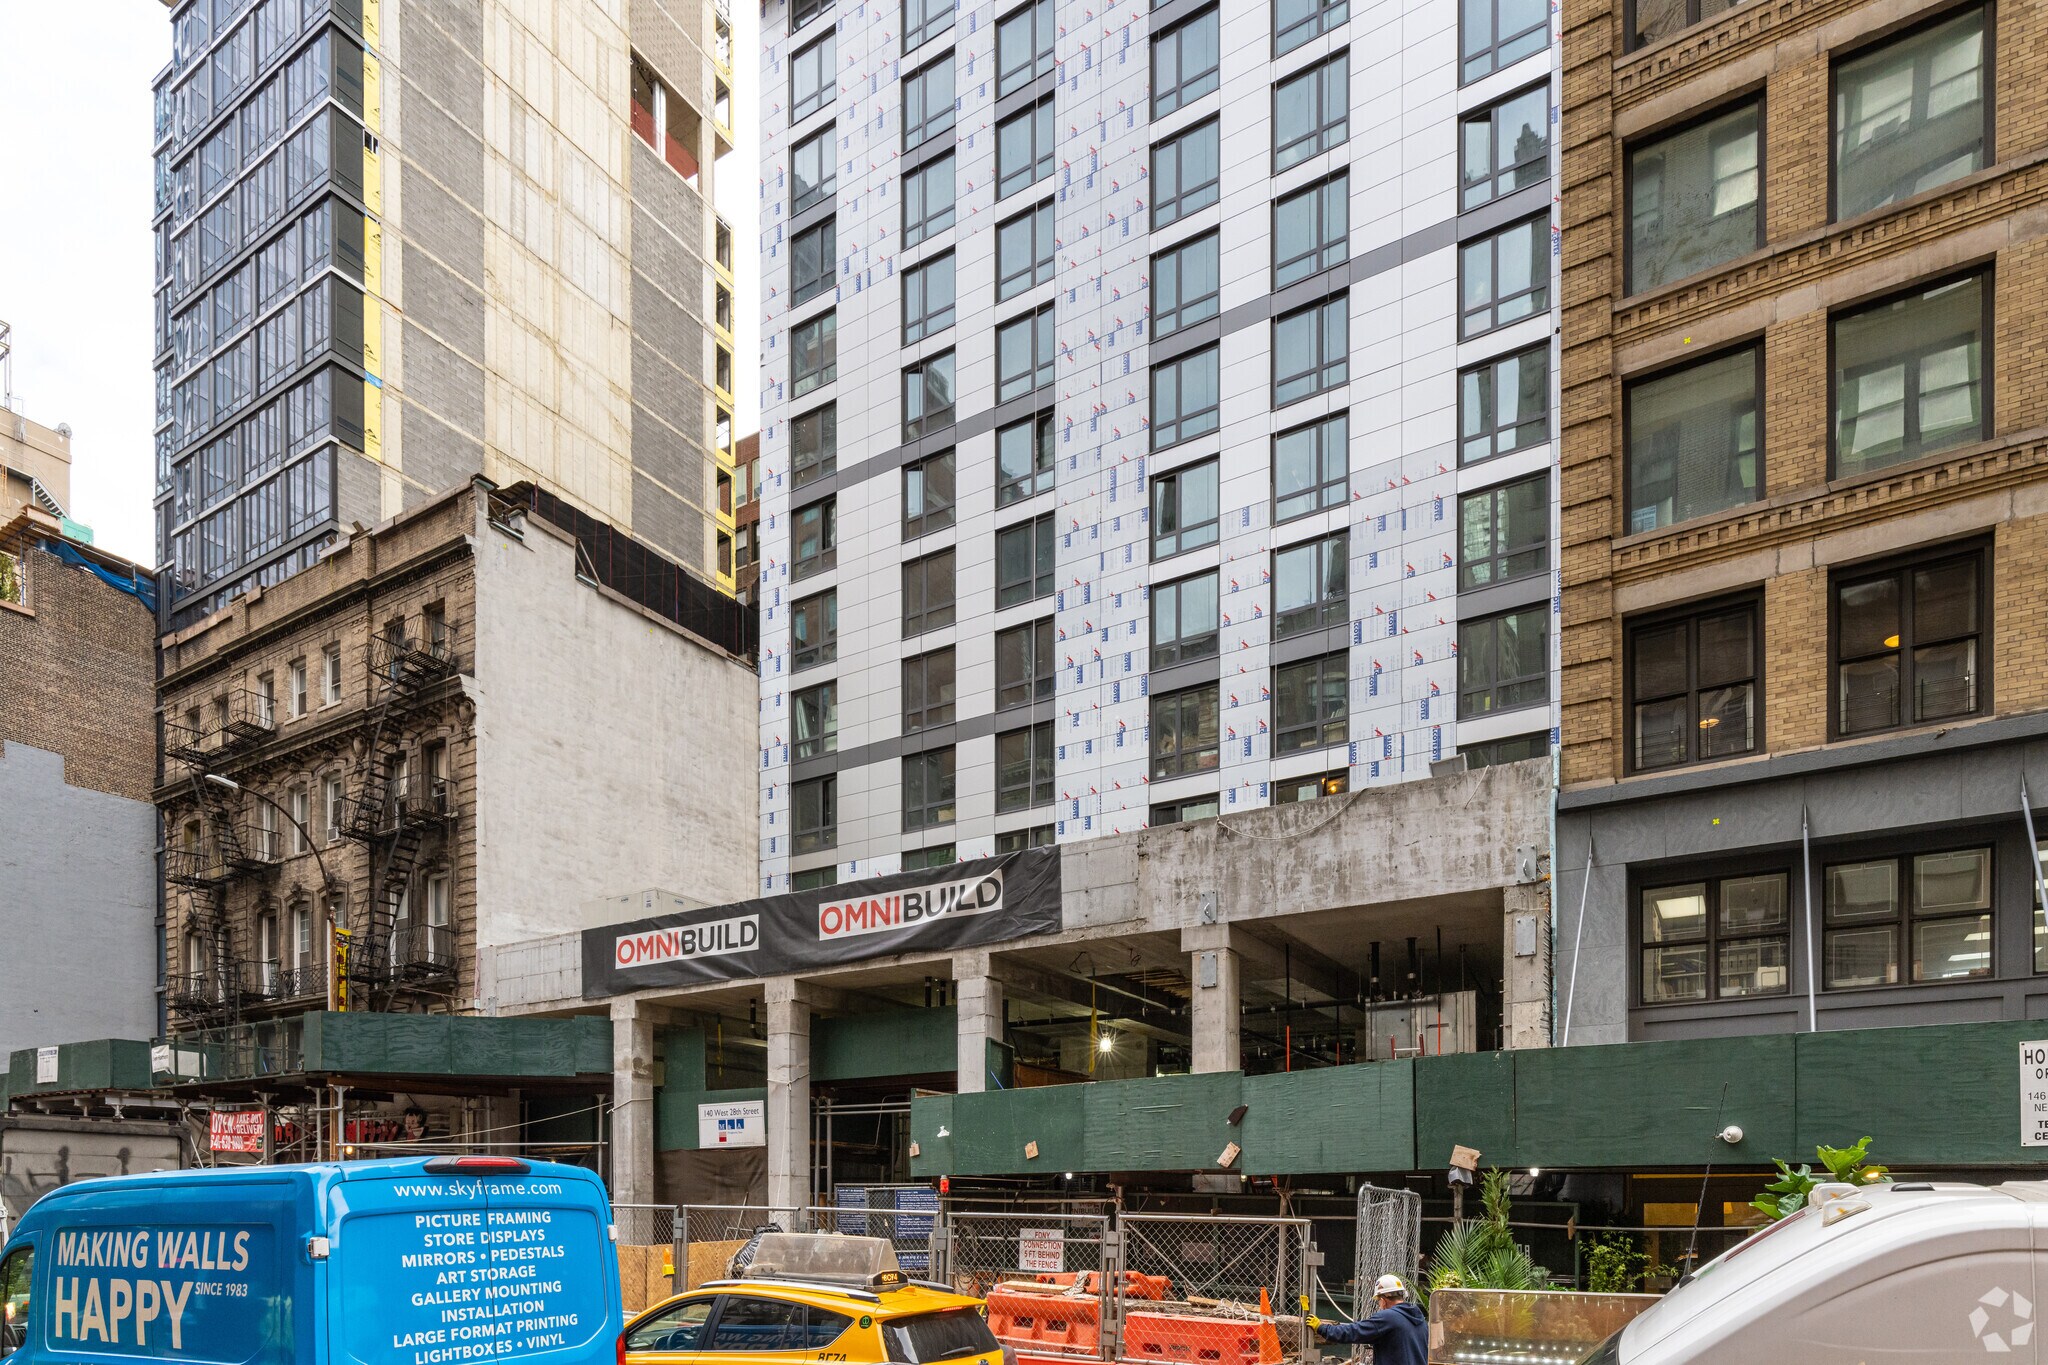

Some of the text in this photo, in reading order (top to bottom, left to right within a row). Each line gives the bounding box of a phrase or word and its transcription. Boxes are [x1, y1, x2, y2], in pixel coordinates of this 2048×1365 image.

[820, 875, 1001, 935] OMNIBUILD
[617, 920, 758, 965] OMNIBUILD
[2025, 1049, 2048, 1064] HO
[2028, 1092, 2046, 1100] 146
[212, 1113, 234, 1134] OPEN
[394, 1180, 562, 1200] www.skyframe.com
[416, 1211, 551, 1228] PICTURE FRAMING
[424, 1229, 545, 1247] STORE DISPLAYS
[1024, 1240, 1062, 1250] CONNECTION
[58, 1231, 250, 1272] MAKING WALLS
[402, 1246, 564, 1268] MIRRORS PEDESTALS
[1038, 1250, 1060, 1260] BEHIND
[436, 1266, 536, 1284] ART STORAGE
[1038, 1260, 1058, 1269] FENCE
[412, 1280, 562, 1306] GALLERY MOUNTING
[56, 1276, 248, 1350] HAPPY SINCE 1983
[442, 1300, 544, 1322] INSTALLATION
[394, 1314, 578, 1348] LARGE FORMAT PRINTING
[415, 1333, 565, 1365] LIGHTBOXES VINYL
